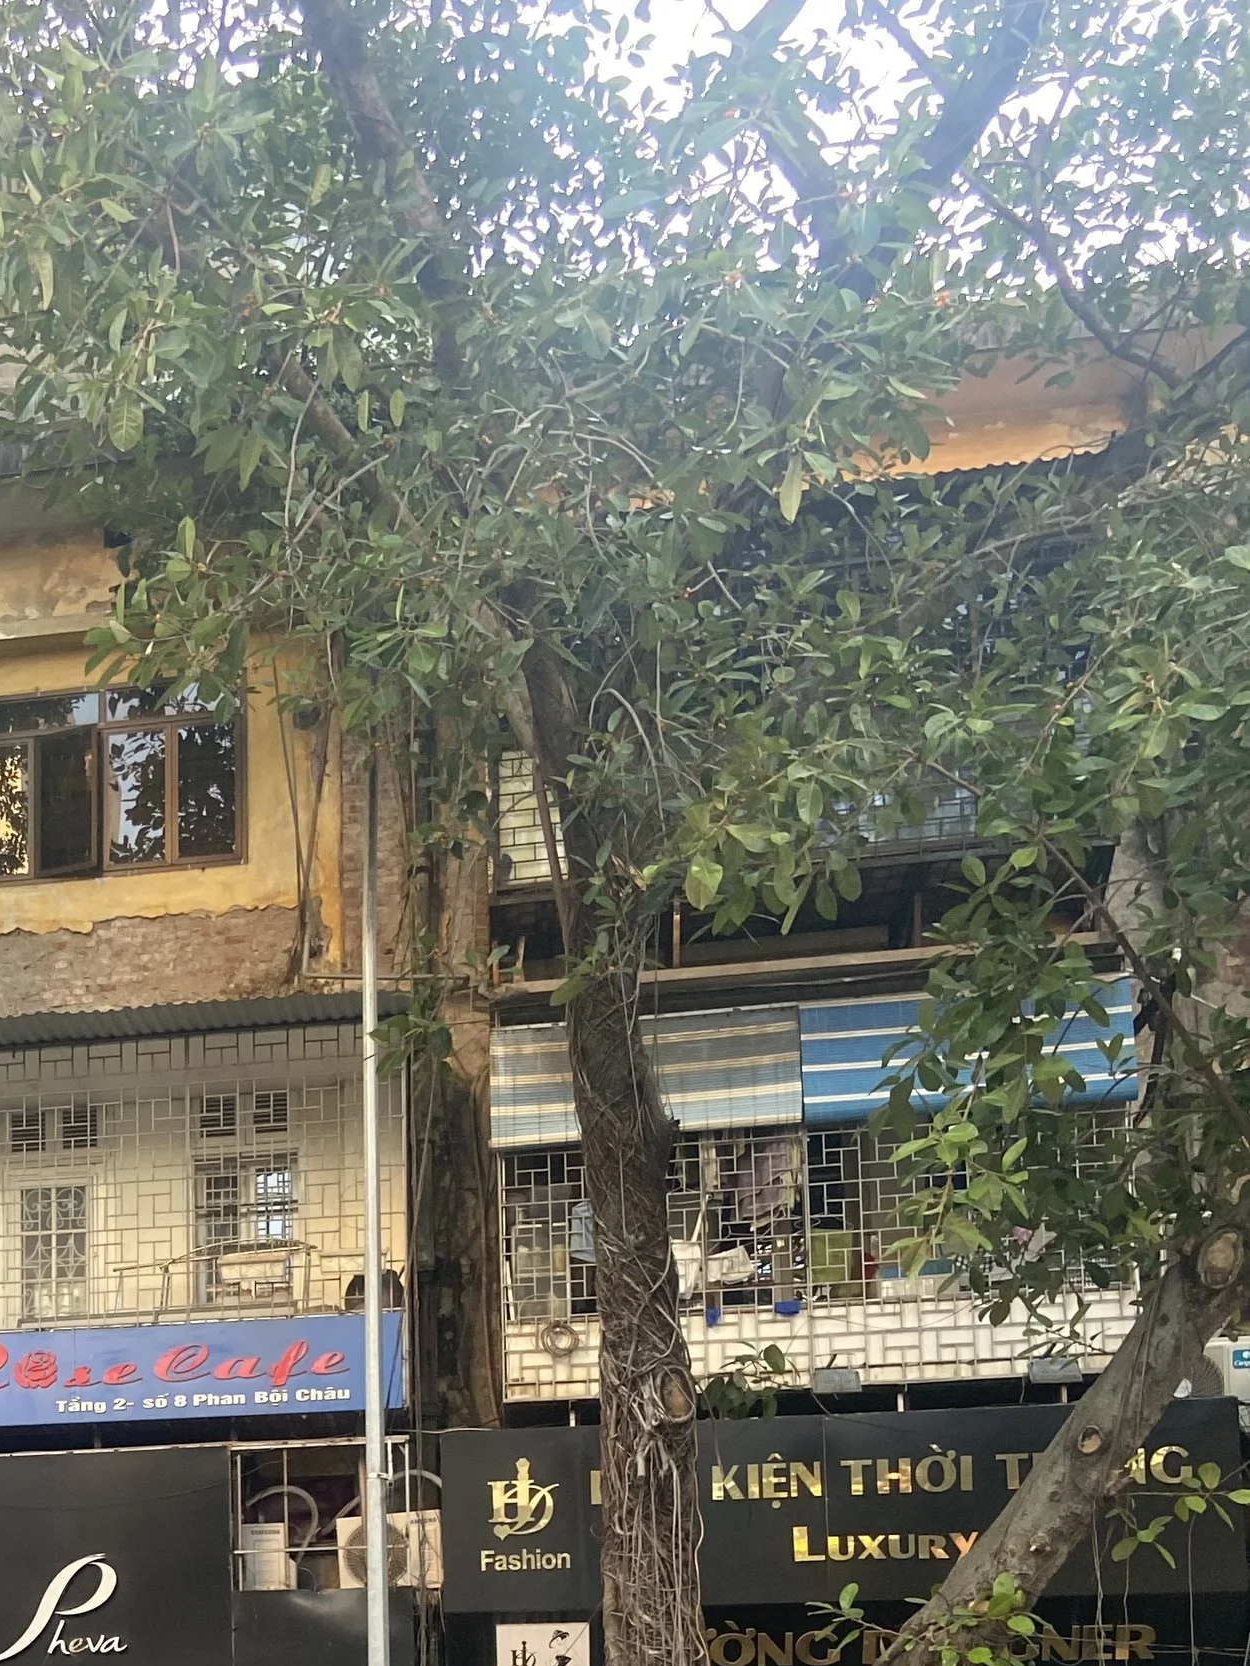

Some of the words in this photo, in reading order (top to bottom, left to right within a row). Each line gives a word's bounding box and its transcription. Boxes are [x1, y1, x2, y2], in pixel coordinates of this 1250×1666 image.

[153, 1340, 350, 1387] Cafe
[56, 1397, 106, 1414] Tầng
[143, 1391, 169, 1409] số
[174, 1394, 187, 1407] 8
[193, 1392, 246, 1407] Phan
[255, 1389, 288, 1407] Bội
[296, 1385, 351, 1402] Châu
[711, 1452, 823, 1509] KIỆN
[841, 1443, 973, 1496] THỜI
[480, 1549, 571, 1572] Fashion
